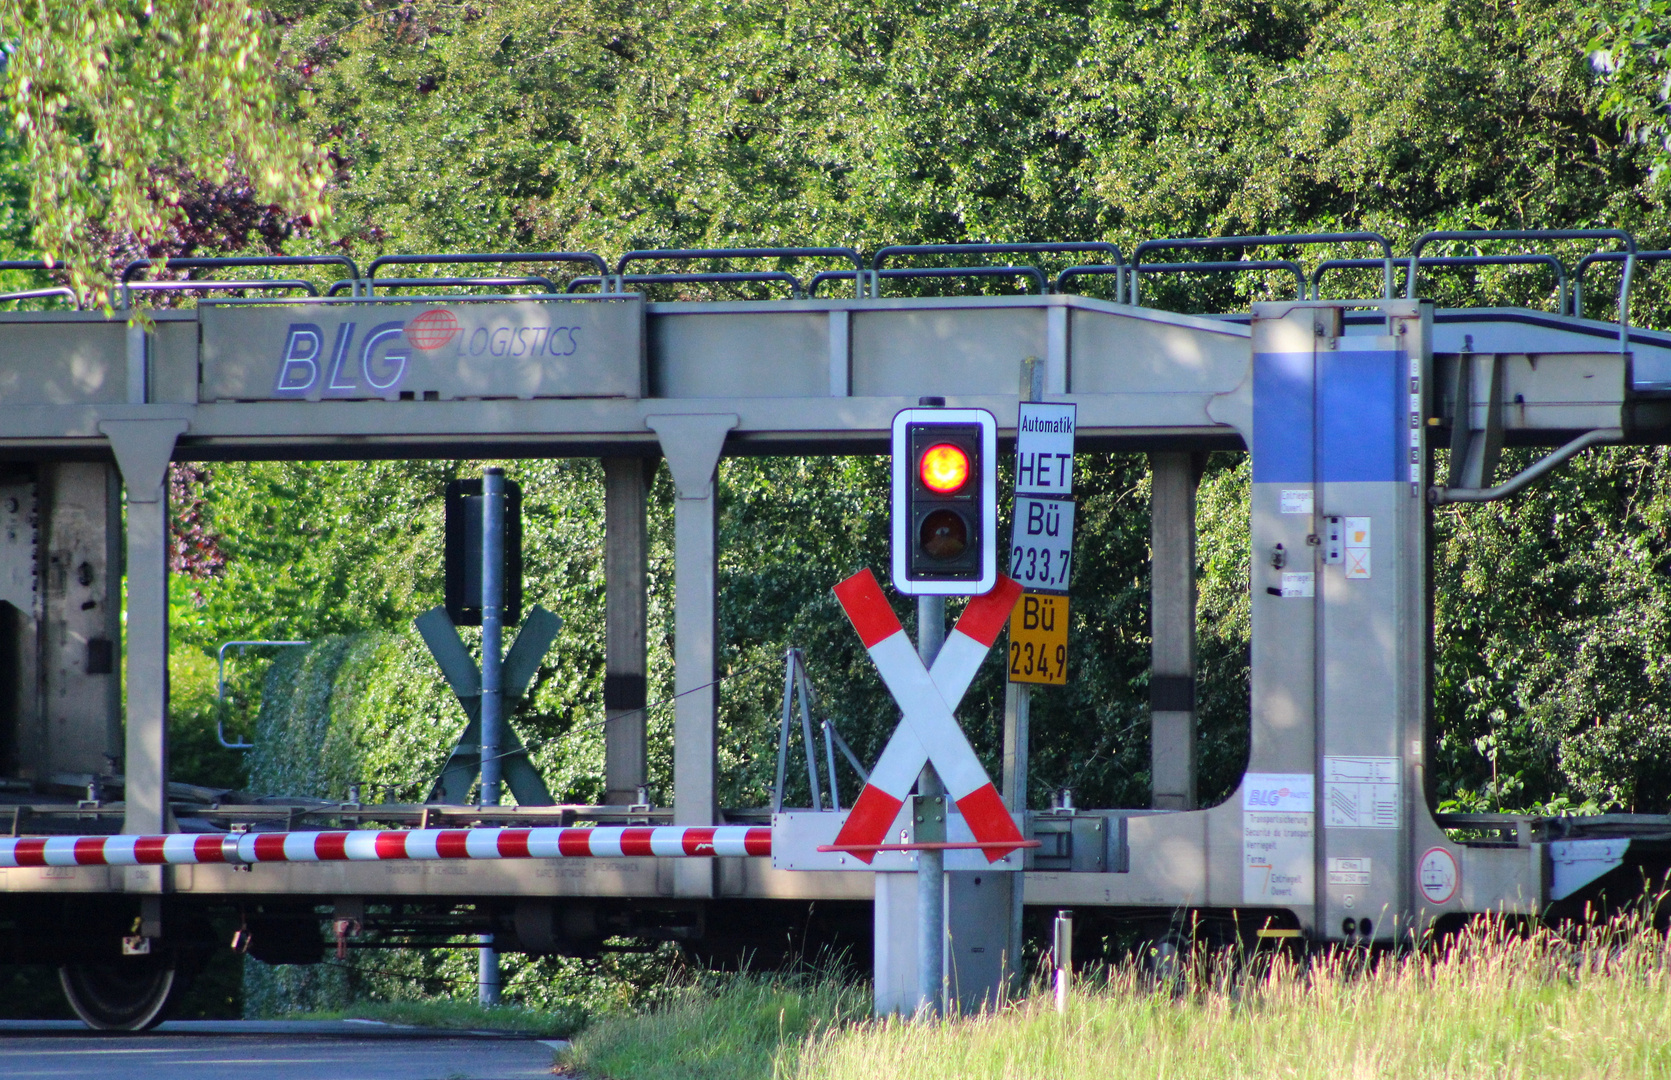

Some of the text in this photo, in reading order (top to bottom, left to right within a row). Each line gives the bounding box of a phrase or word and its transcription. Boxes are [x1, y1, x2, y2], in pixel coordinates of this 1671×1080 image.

[273, 320, 582, 396] BLG LOGISTICS
[1021, 414, 1073, 434] Automatik
[1018, 452, 1071, 487] HET
[1027, 501, 1060, 537] Bü
[1011, 545, 1071, 586] 233,7
[1023, 596, 1055, 632] Bü
[1010, 641, 1066, 682] 234,9
[1248, 789, 1280, 806] BLG
